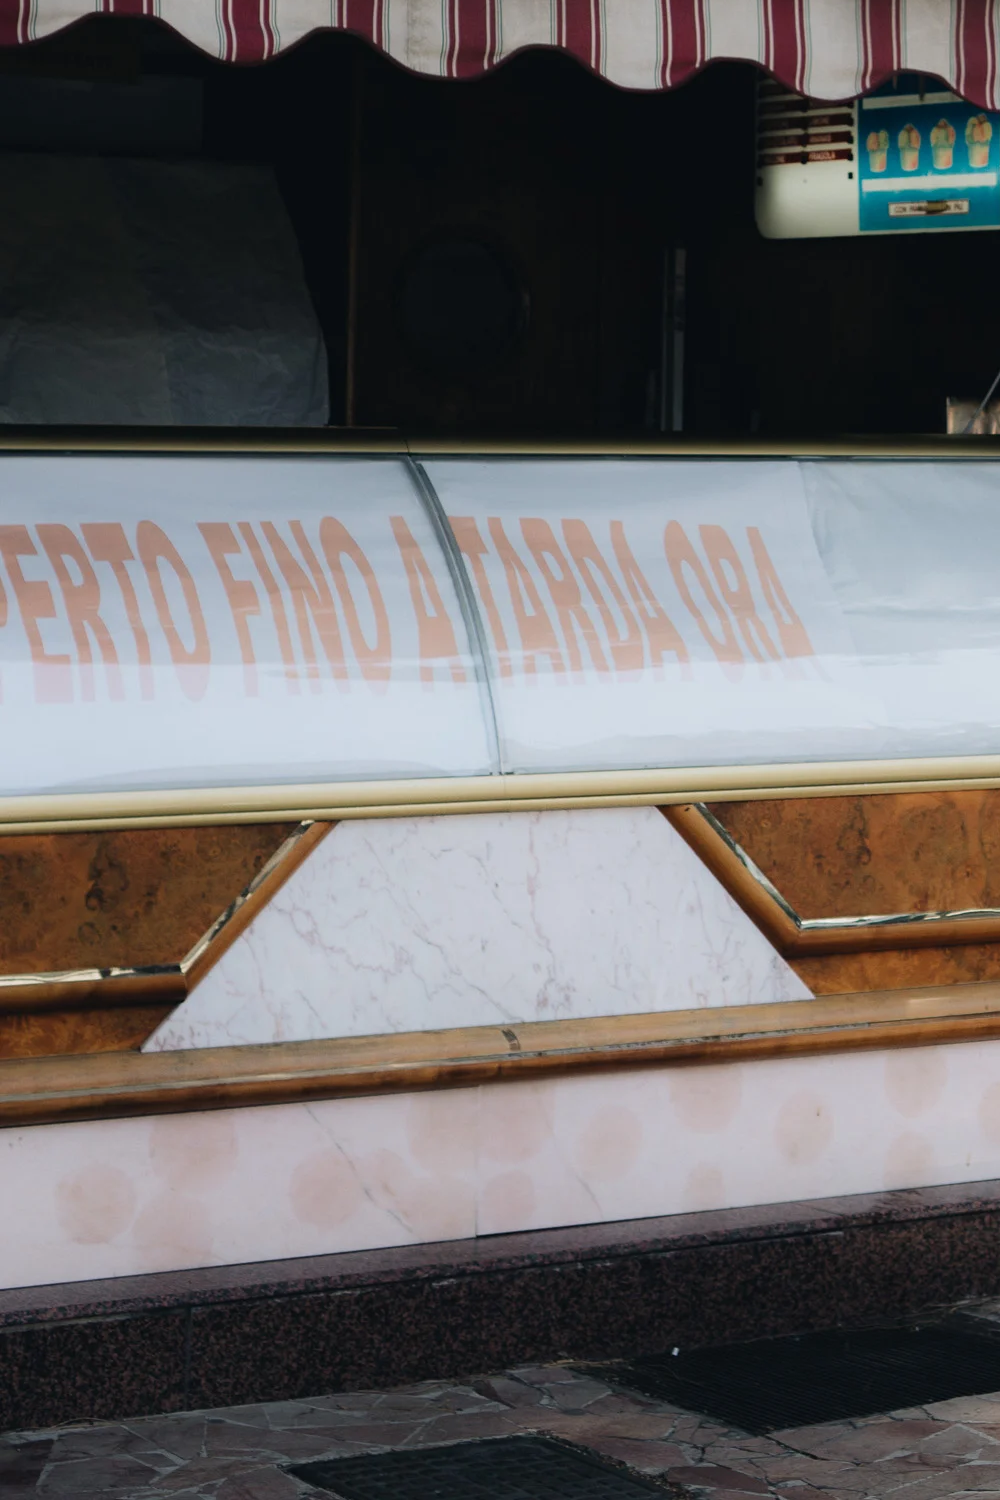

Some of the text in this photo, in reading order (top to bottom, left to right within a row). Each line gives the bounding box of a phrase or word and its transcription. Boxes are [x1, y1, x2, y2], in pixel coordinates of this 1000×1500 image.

[0, 516, 833, 704] ERTO FINO A TARDA ORA
